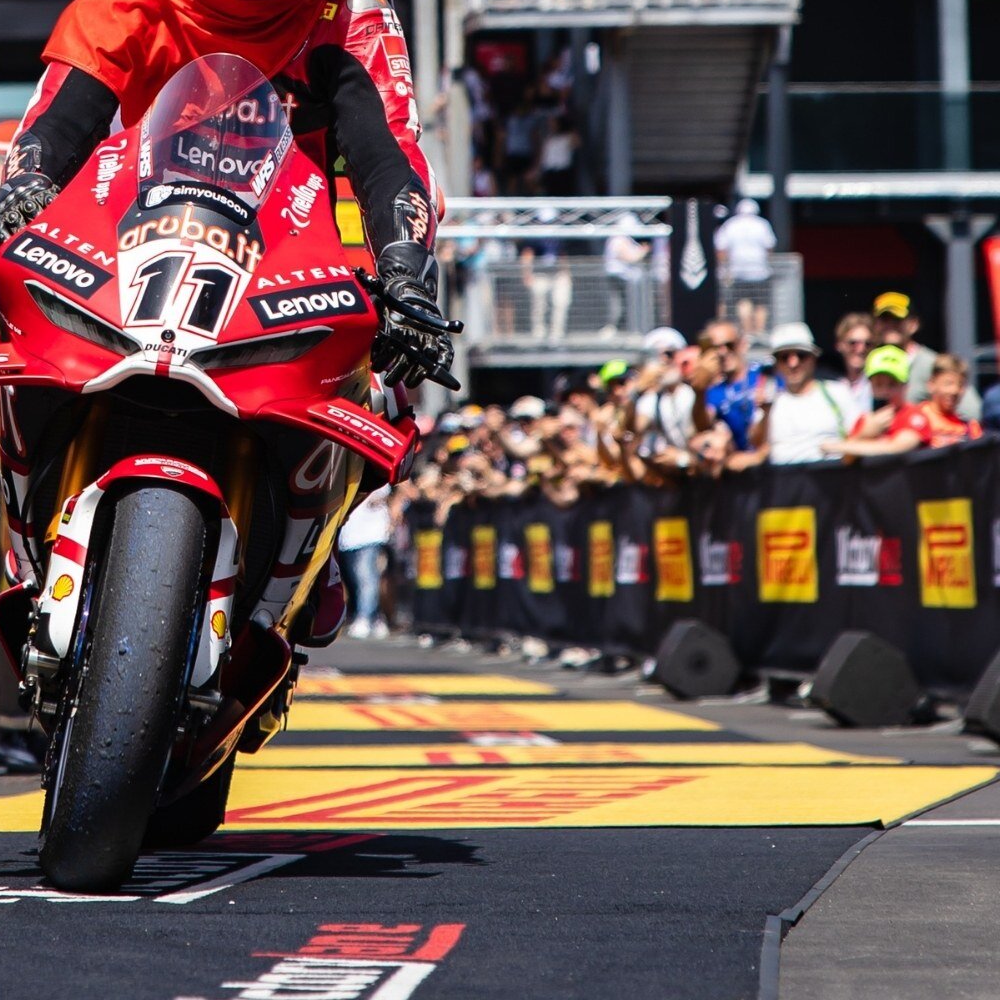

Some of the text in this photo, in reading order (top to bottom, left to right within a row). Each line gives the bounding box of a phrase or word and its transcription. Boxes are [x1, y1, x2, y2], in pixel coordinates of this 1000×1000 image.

[31, 222, 117, 267] ALTEN
[118, 203, 262, 274] aruba.it
[13, 237, 95, 289] Lenovo
[257, 265, 349, 290] ALTEN
[122, 250, 242, 340] 11
[259, 289, 357, 321] Lenovo
[144, 342, 188, 358] DUCATI
